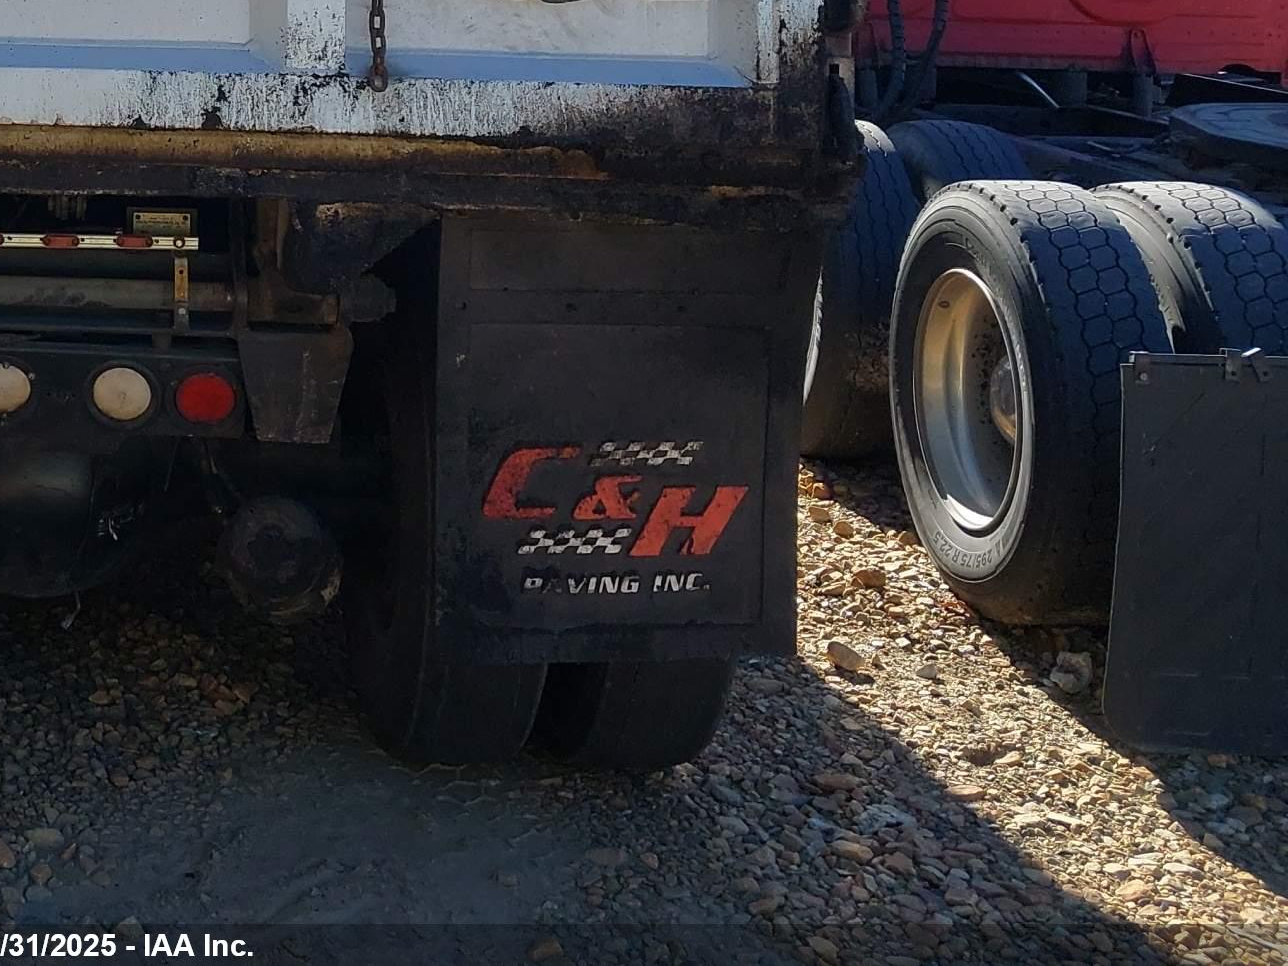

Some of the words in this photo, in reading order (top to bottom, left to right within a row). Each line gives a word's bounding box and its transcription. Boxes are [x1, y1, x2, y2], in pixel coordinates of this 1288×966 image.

[481, 445, 750, 558] C&H
[522, 573, 640, 595] PAVING
[652, 573, 711, 593] INC.
